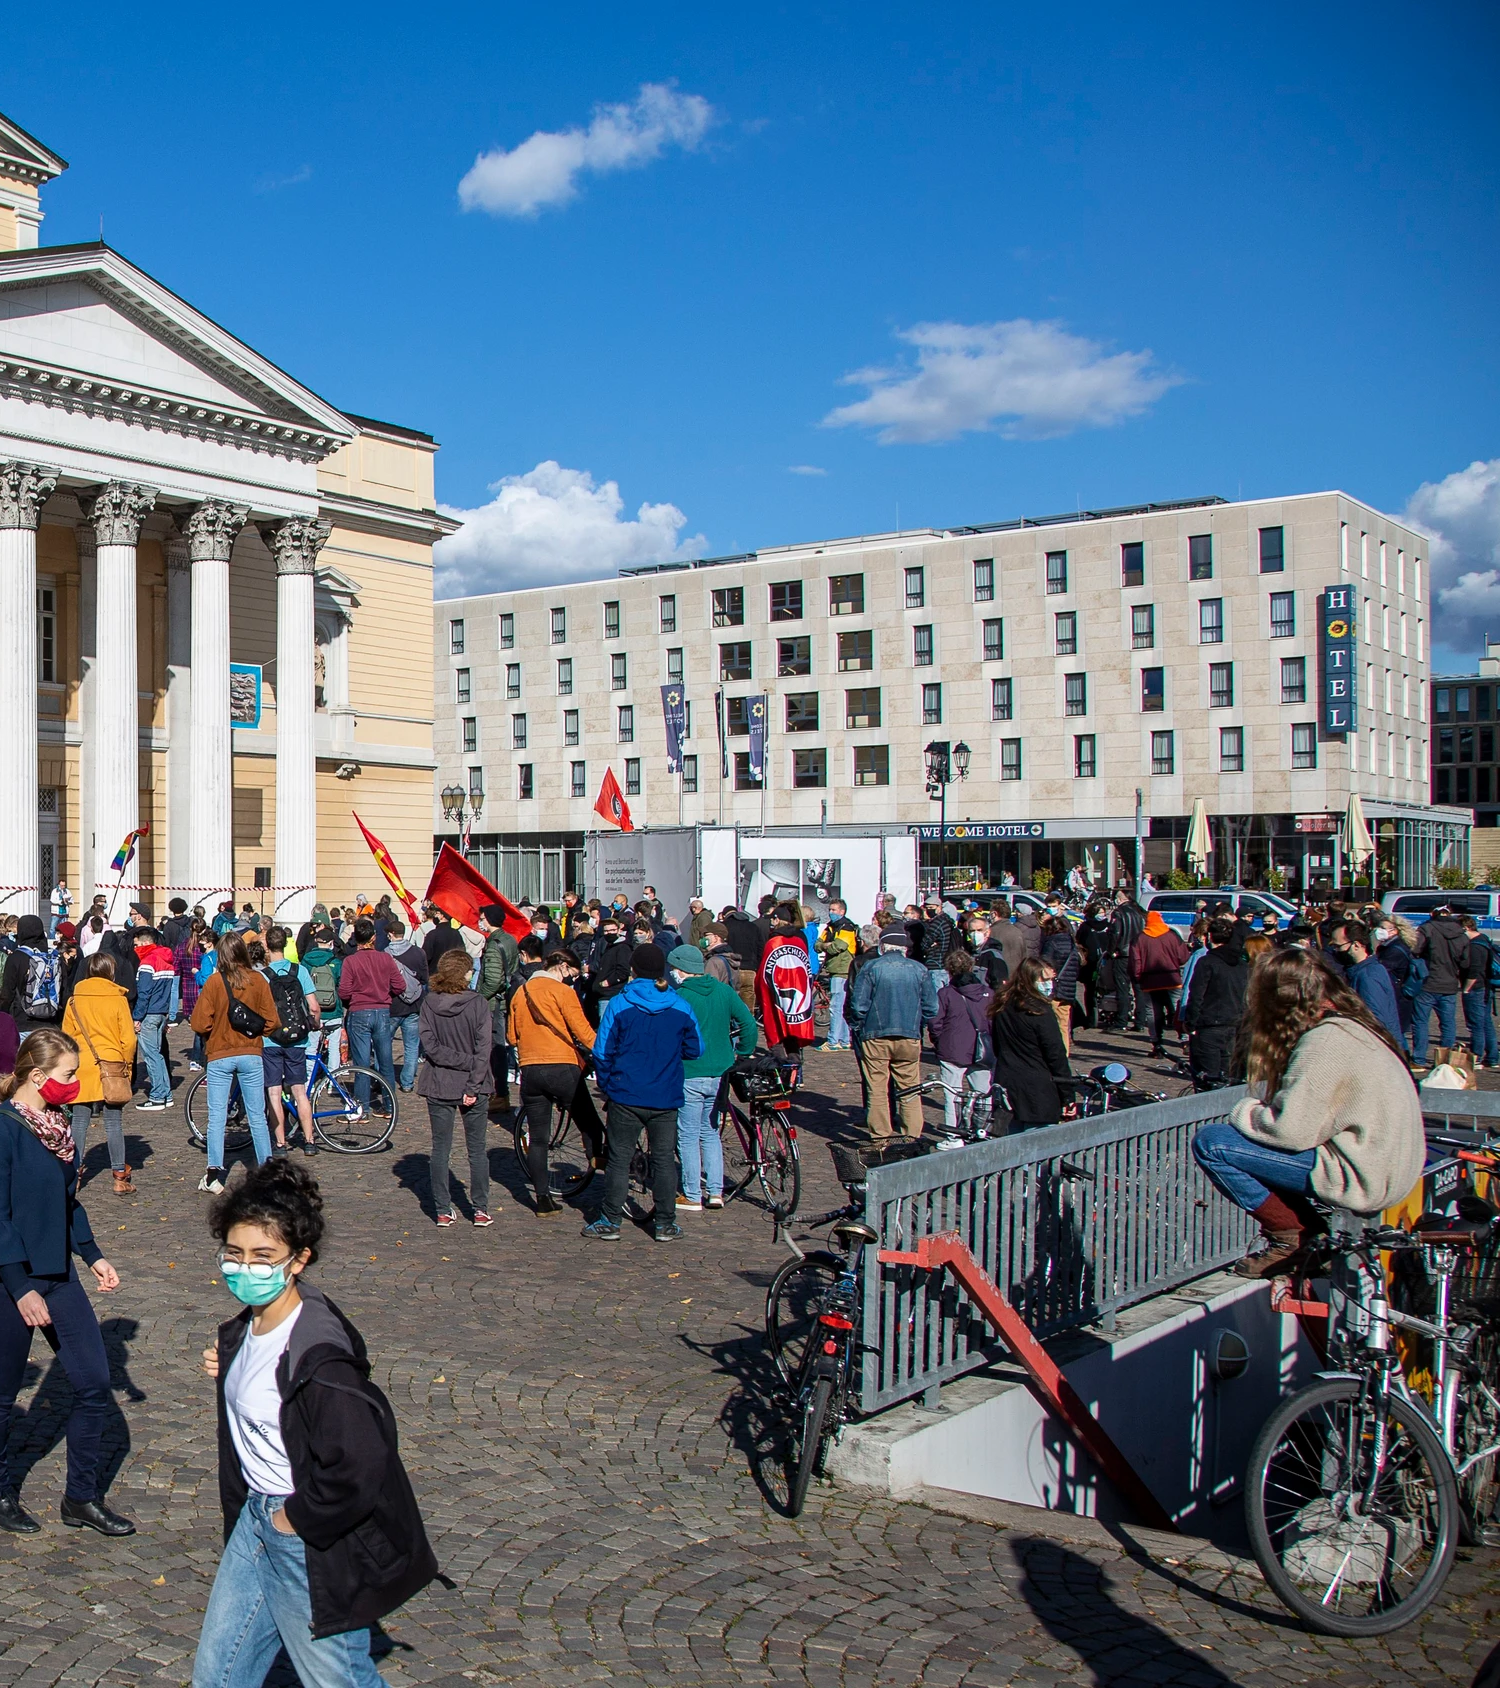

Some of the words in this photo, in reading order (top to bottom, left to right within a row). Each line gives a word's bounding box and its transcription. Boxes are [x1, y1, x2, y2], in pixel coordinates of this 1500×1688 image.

[1327, 590, 1348, 727] HOTEL
[987, 825, 1030, 836] HOTEL
[766, 946, 812, 978] ANTIFASCHISTISCH
